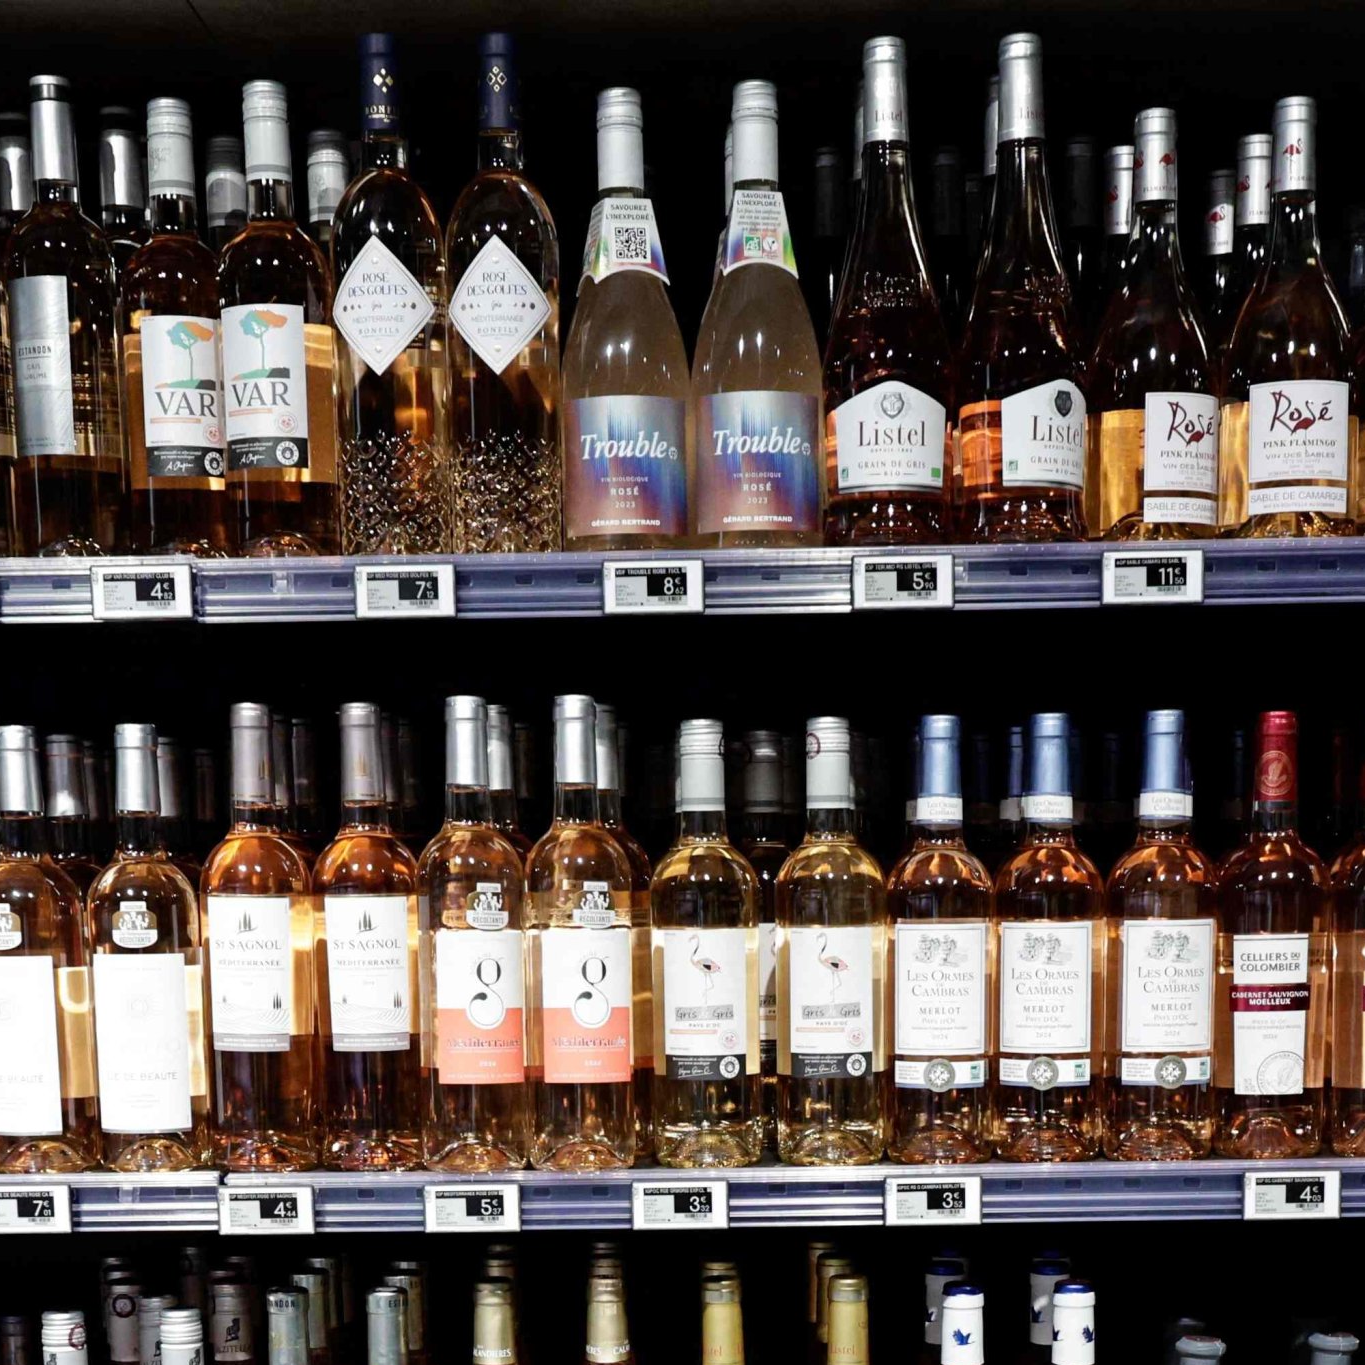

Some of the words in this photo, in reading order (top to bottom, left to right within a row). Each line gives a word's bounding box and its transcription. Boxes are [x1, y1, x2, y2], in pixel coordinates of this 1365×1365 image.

[610, 203, 649, 213] SAVOUREZ
[348, 285, 371, 298] DES
[373, 284, 408, 297] GOLFES
[358, 326, 400, 336] BONFILS
[18, 345, 52, 356] ESTANDON
[156, 391, 216, 417] VAR
[859, 421, 927, 447] Listel
[581, 434, 668, 461] Trouble
[713, 429, 801, 457] Trouble
[1263, 440, 1286, 449] PINK
[1290, 438, 1336, 449] FLAMINGO
[1265, 452, 1279, 460] VIN
[1304, 450, 1336, 460] SABLES
[858, 460, 884, 470] GRAIN
[888, 460, 899, 470] DE
[903, 460, 927, 470] GRIS
[1251, 492, 1282, 502] SABLE
[1299, 490, 1345, 502] CAMARGUE
[615, 500, 636, 509] 2023
[591, 518, 623, 528] GÉRARD
[625, 518, 661, 527] BERTRAND
[1240, 952, 1288, 962] CELLIERS
[1240, 962, 1301, 972] COLOMBIER
[1231, 989, 1270, 999] CABERNET
[1271, 988, 1309, 998] SAUVIGNON
[1249, 997, 1291, 1006] MOELLEUX
[919, 1005, 961, 1015] MERLOT
